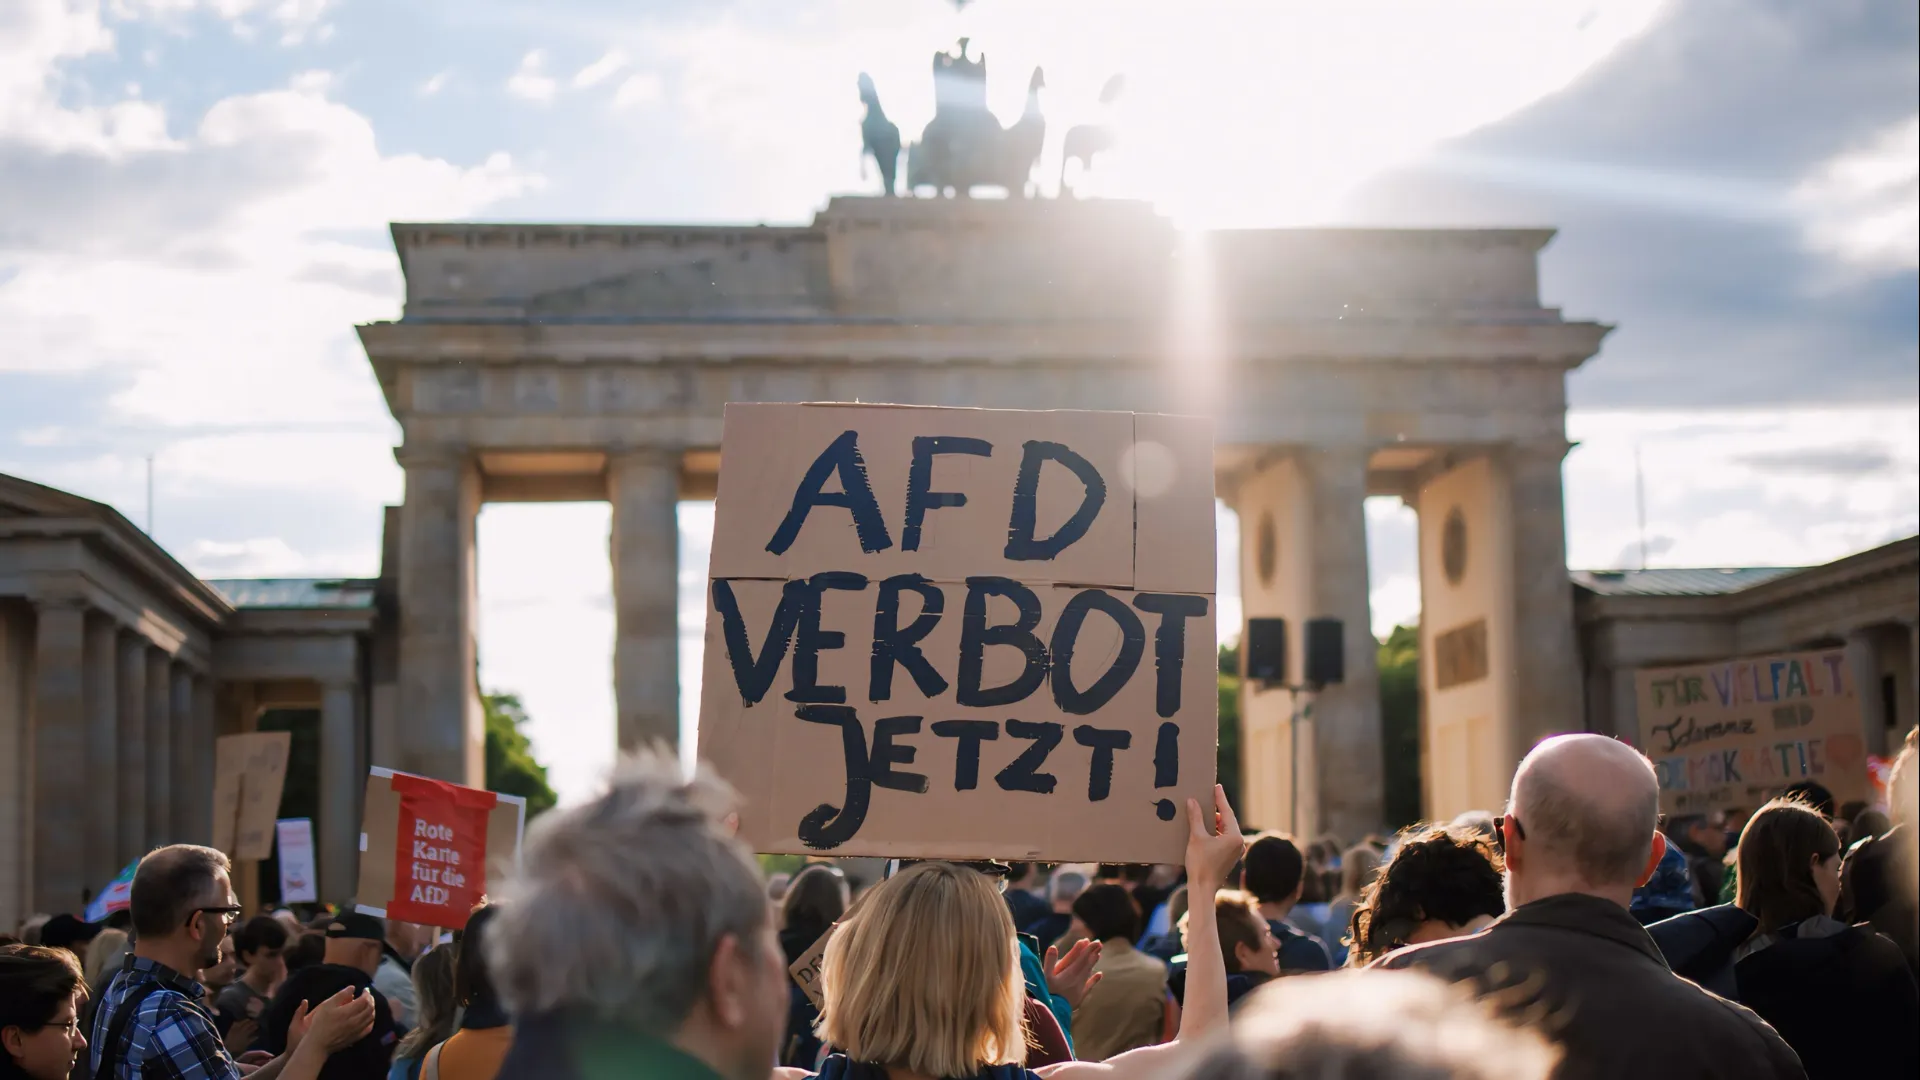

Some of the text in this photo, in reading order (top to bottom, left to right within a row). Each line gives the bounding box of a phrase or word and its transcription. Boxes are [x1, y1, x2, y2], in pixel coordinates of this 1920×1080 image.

[765, 430, 1107, 561] AFD
[711, 571, 1208, 718] VERBOT
[794, 703, 1181, 850] JETZT!
[414, 818, 453, 841] Rote
[413, 840, 460, 865] Karte
[412, 861, 465, 888] für die
[410, 884, 449, 907] AfD!
[797, 953, 823, 984] DE
